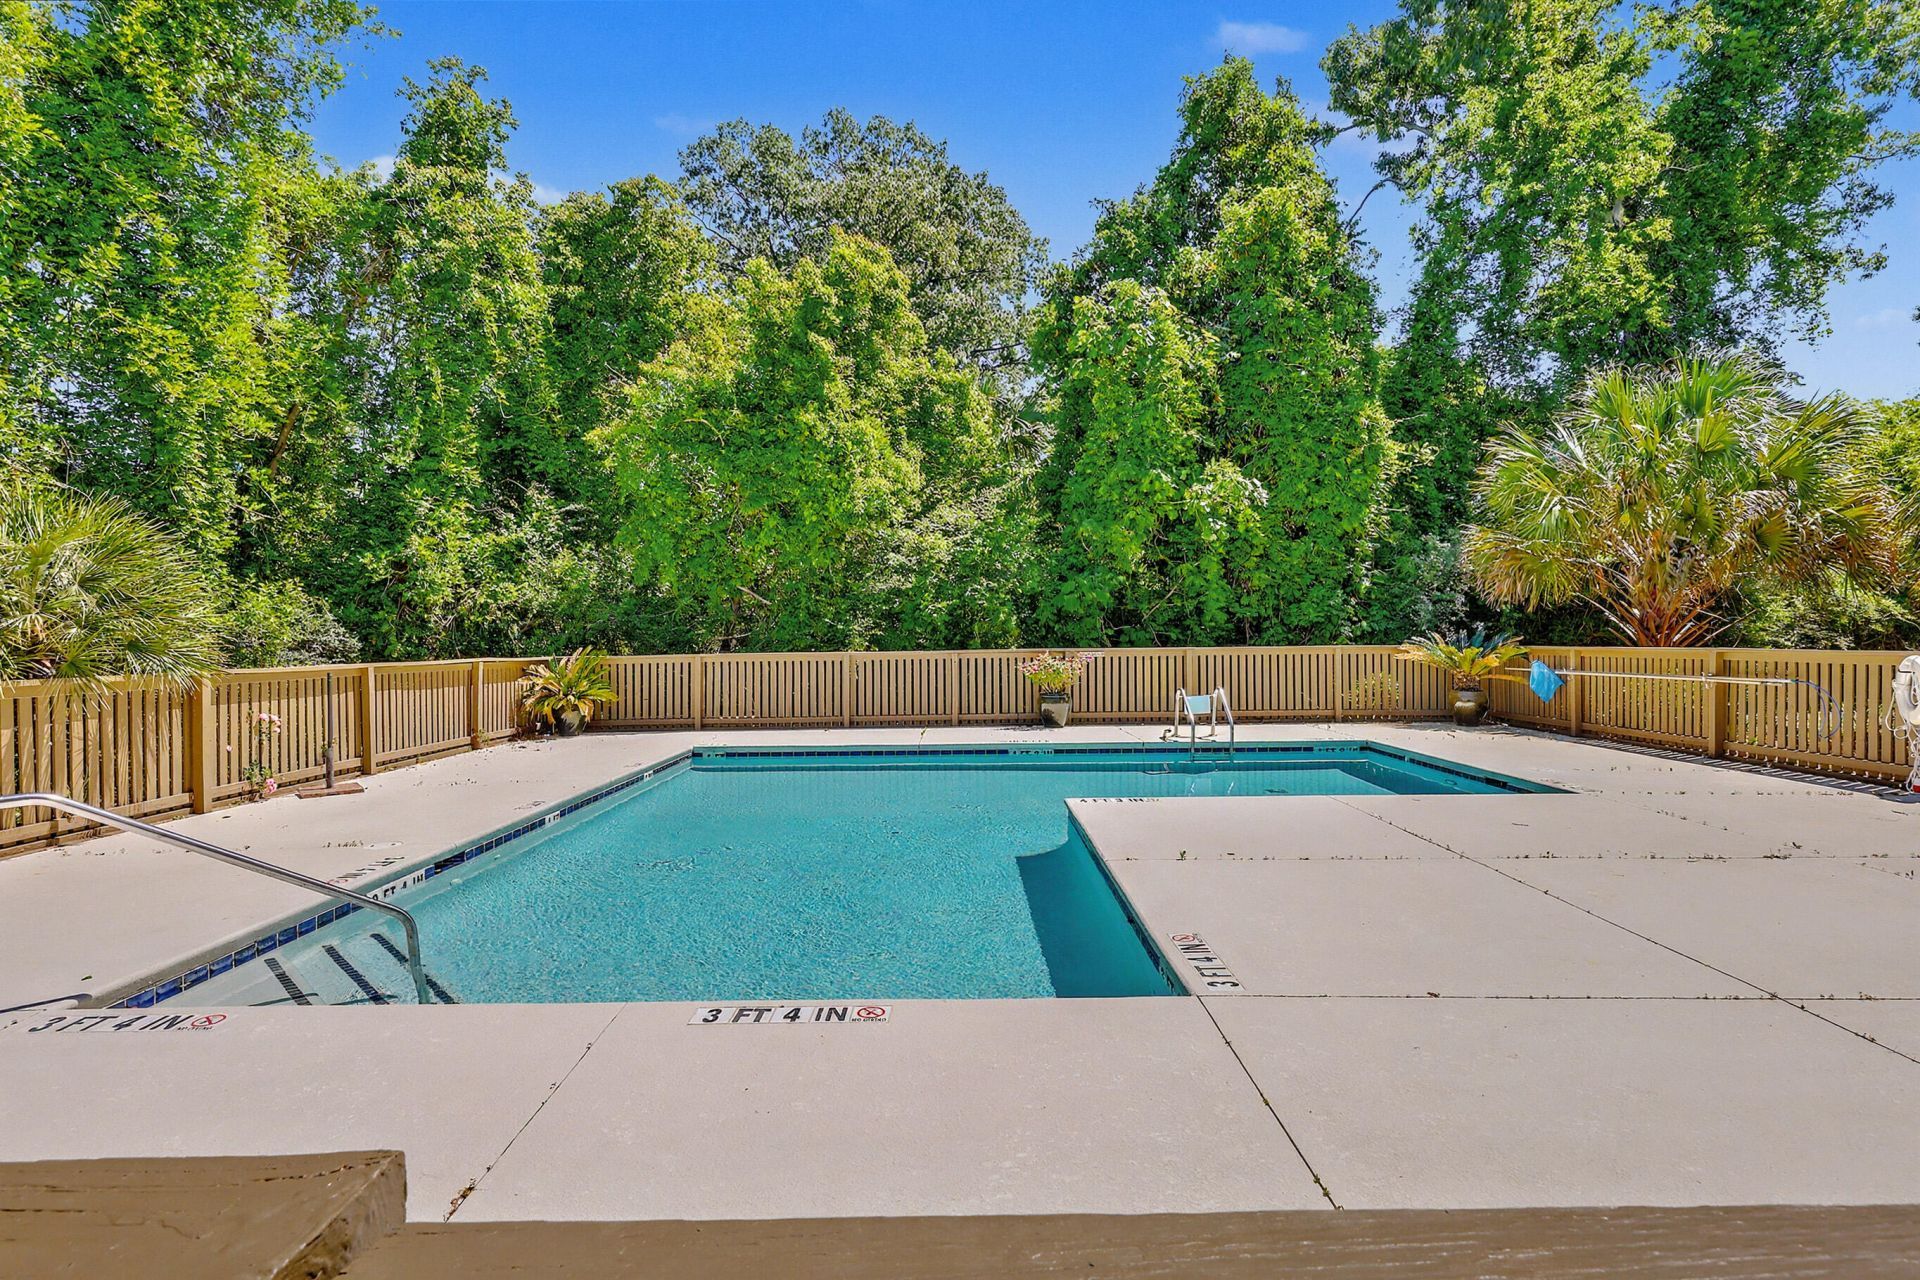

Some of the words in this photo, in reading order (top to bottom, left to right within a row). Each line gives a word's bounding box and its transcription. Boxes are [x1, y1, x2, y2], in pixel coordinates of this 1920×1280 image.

[1178, 943, 1212, 954] IN
[1193, 965, 1232, 978] FT
[702, 1008, 722, 1023] 3
[731, 1008, 773, 1023] FT
[783, 1007, 801, 1022] 4
[814, 1007, 849, 1022] IN
[28, 1016, 67, 1032] 3
[55, 1015, 120, 1032] FT
[112, 1015, 148, 1031] 4
[139, 1014, 195, 1031] IN
